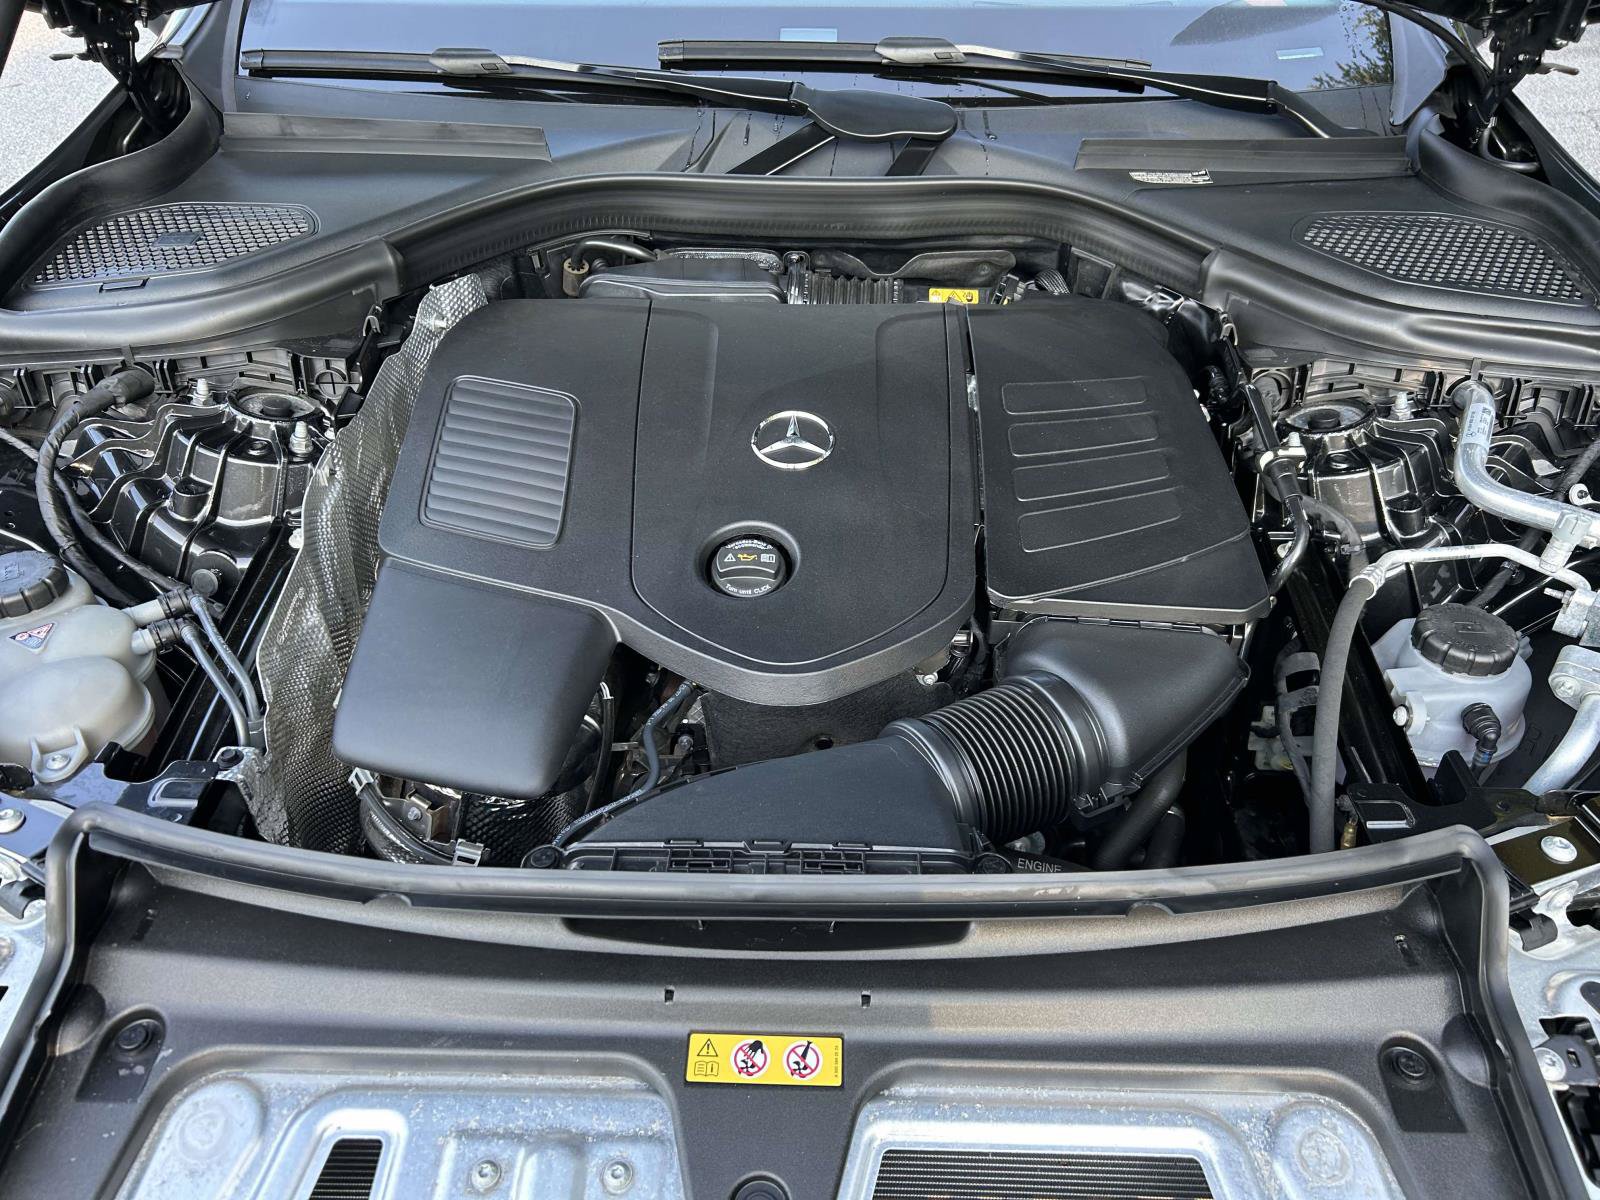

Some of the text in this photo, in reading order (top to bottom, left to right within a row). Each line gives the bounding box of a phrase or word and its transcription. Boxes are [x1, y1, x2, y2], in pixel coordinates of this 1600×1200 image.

[726, 583, 738, 593] Turn
[754, 583, 771, 594] CLICK
[1017, 858, 1062, 873] ENGINE
